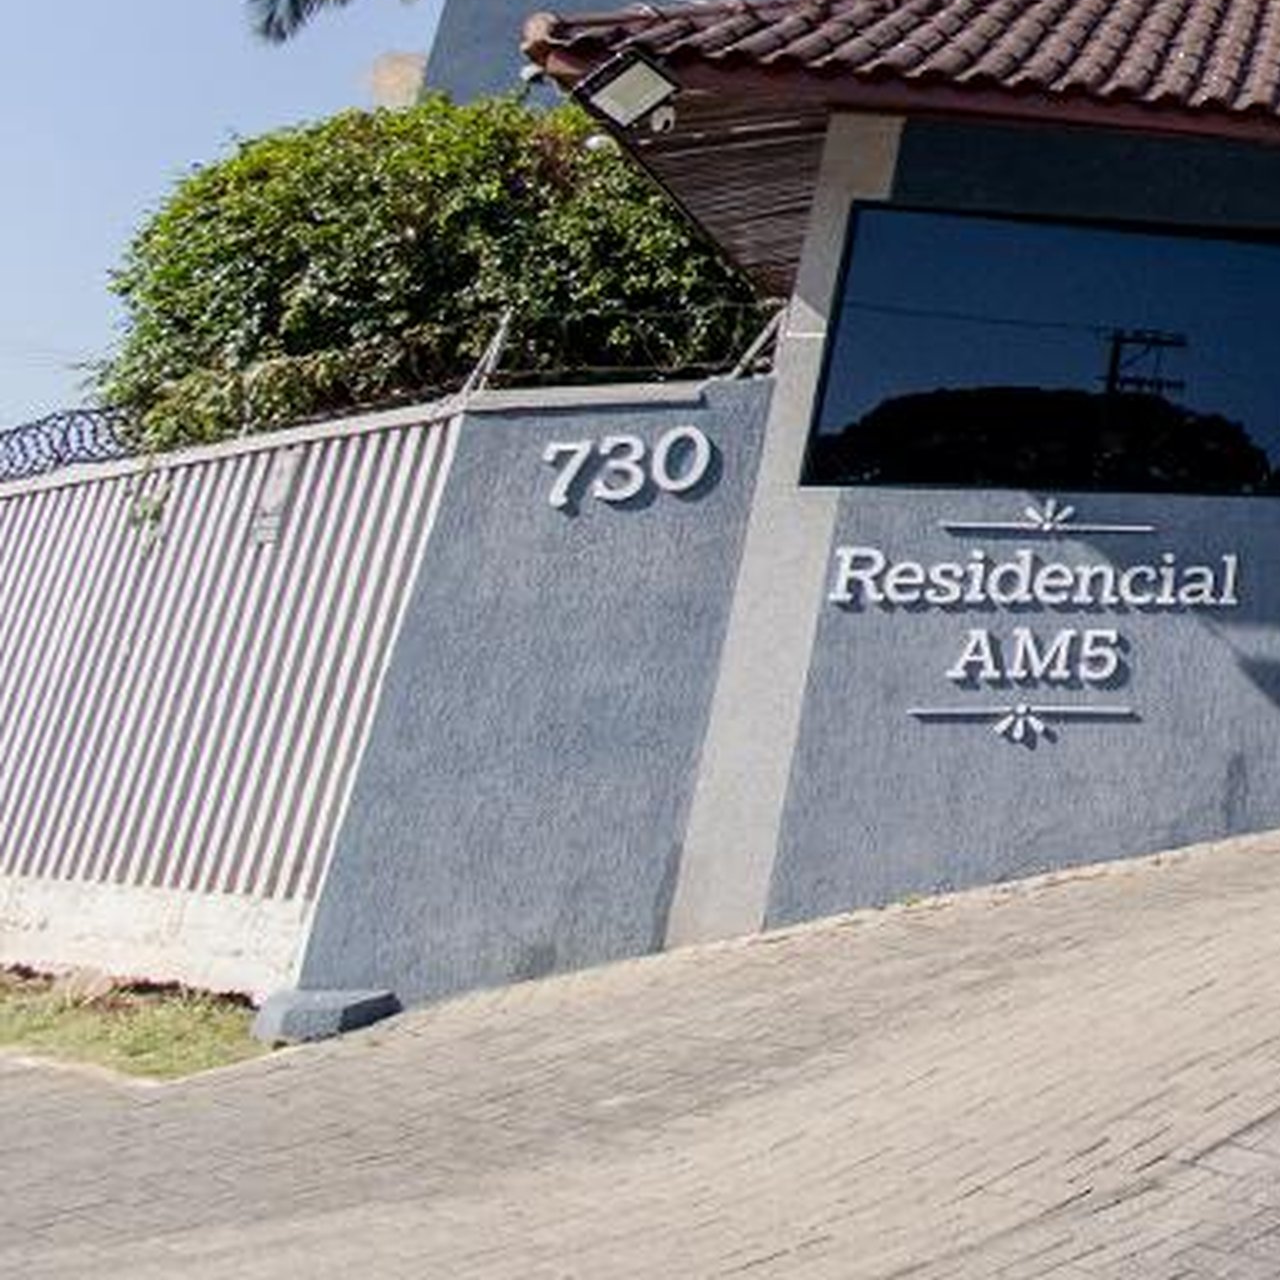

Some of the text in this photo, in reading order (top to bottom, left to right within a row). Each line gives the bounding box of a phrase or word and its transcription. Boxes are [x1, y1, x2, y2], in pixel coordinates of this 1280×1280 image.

[541, 425, 711, 508] 730
[828, 546, 1239, 605] Residencial
[945, 626, 1120, 680] AM5
